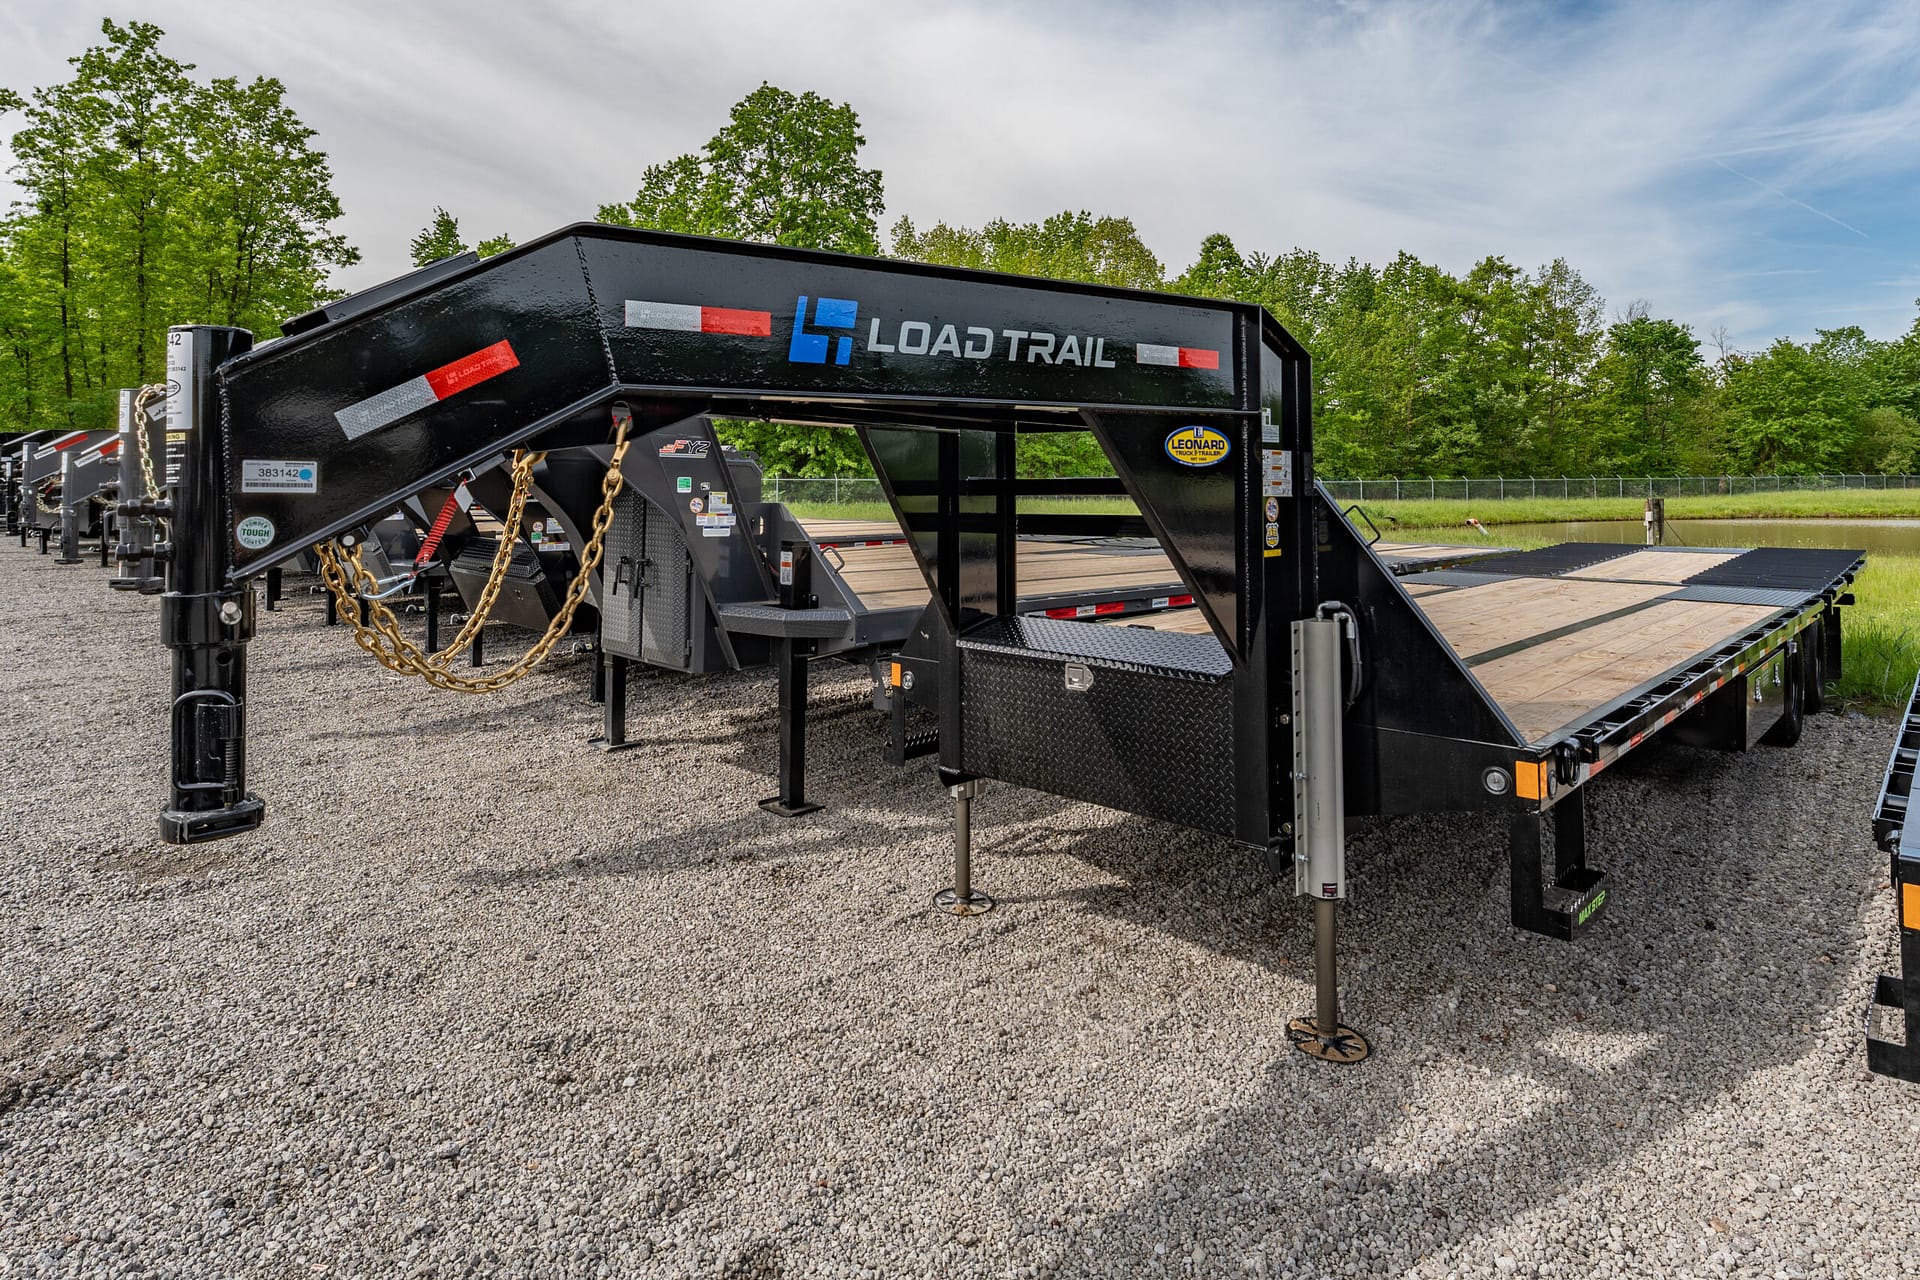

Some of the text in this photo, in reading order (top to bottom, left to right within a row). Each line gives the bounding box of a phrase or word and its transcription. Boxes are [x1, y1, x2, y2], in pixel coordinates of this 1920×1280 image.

[867, 318, 1117, 369] LOAD TRAIL
[457, 363, 481, 379] LOAD
[1171, 439, 1225, 450] LEONARD
[258, 468, 299, 478] 383142
[242, 528, 271, 537] TOUGH
[1578, 890, 1606, 926] MAX STEP
